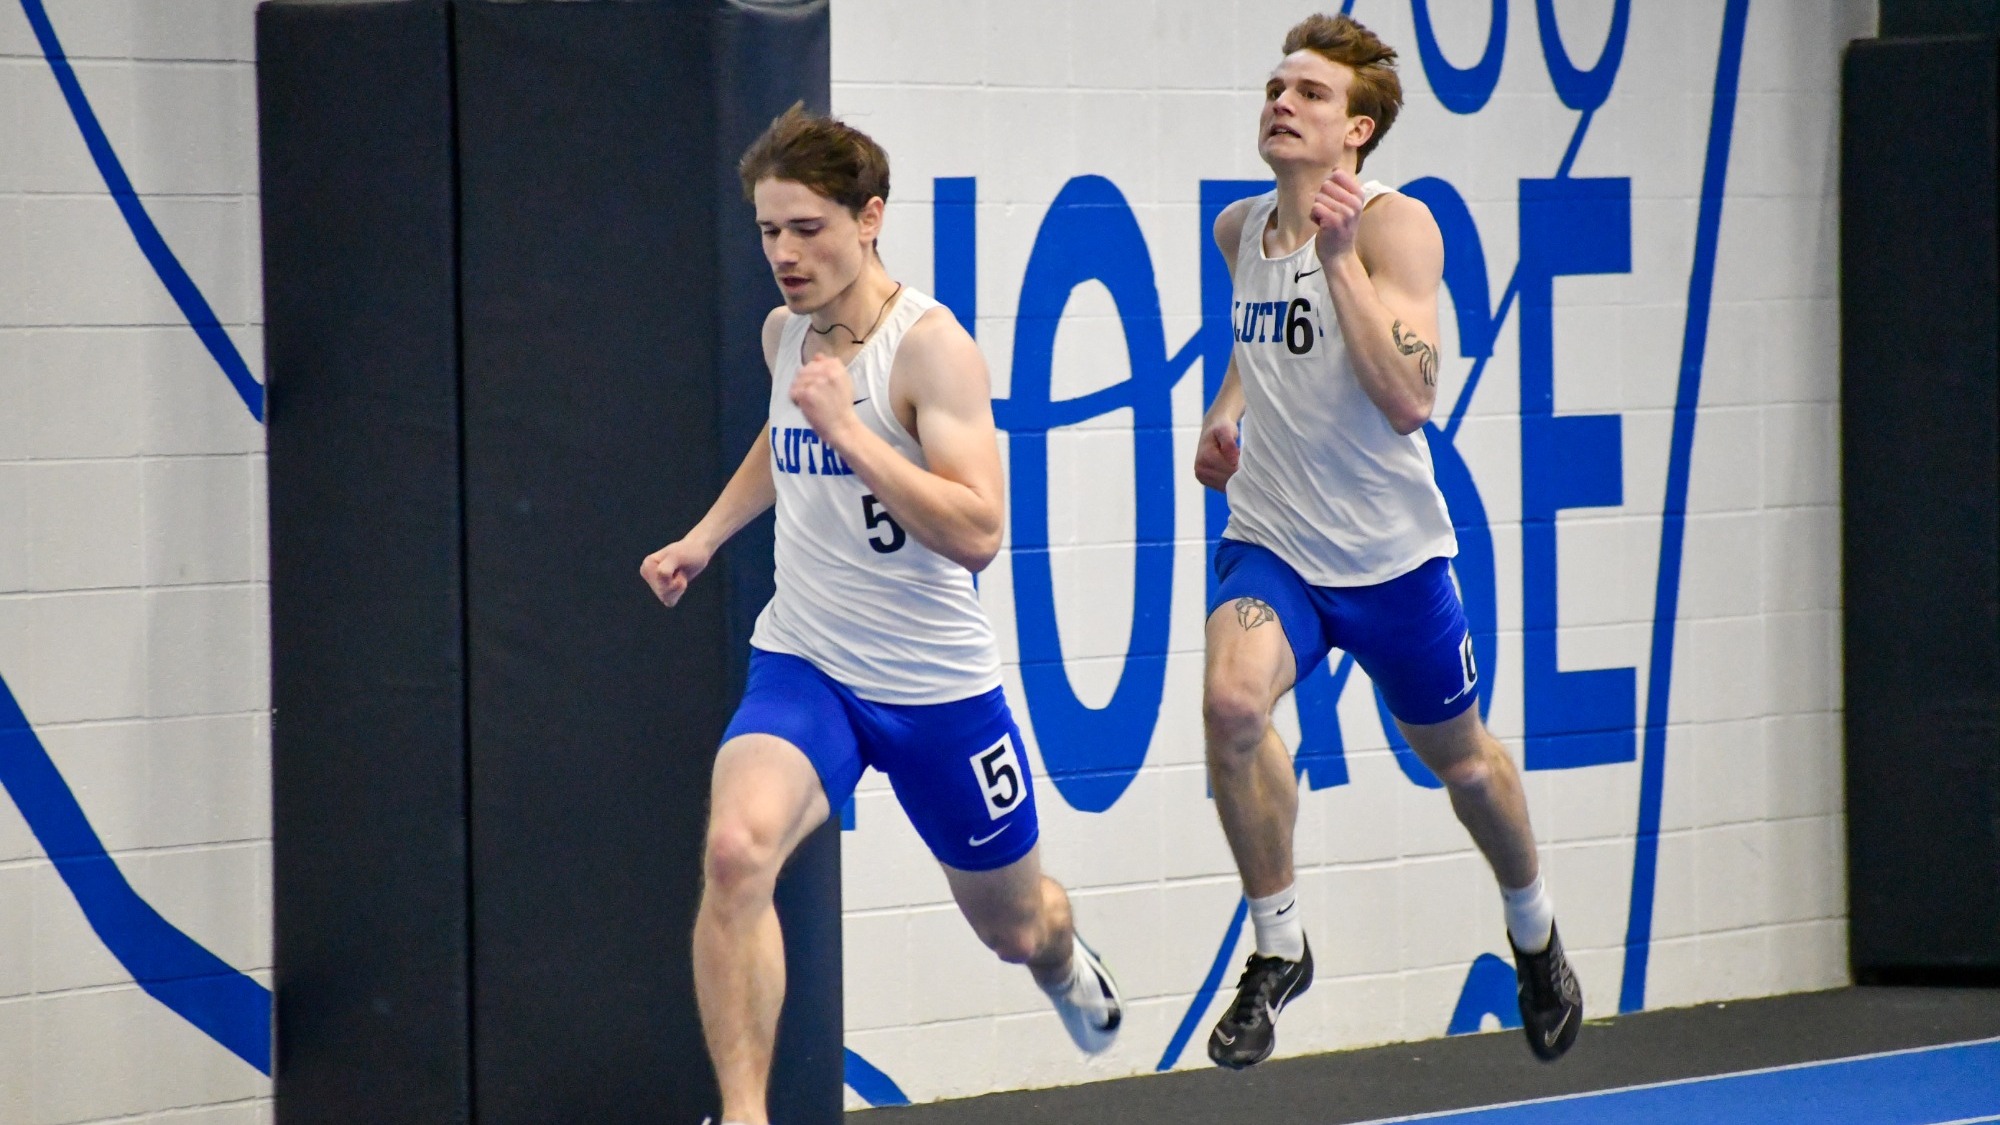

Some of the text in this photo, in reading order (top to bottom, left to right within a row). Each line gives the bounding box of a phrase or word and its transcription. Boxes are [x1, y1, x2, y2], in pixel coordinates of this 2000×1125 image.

[1286, 297, 1314, 355] 6
[861, 494, 906, 554] 5
[980, 743, 1019, 808] 5
